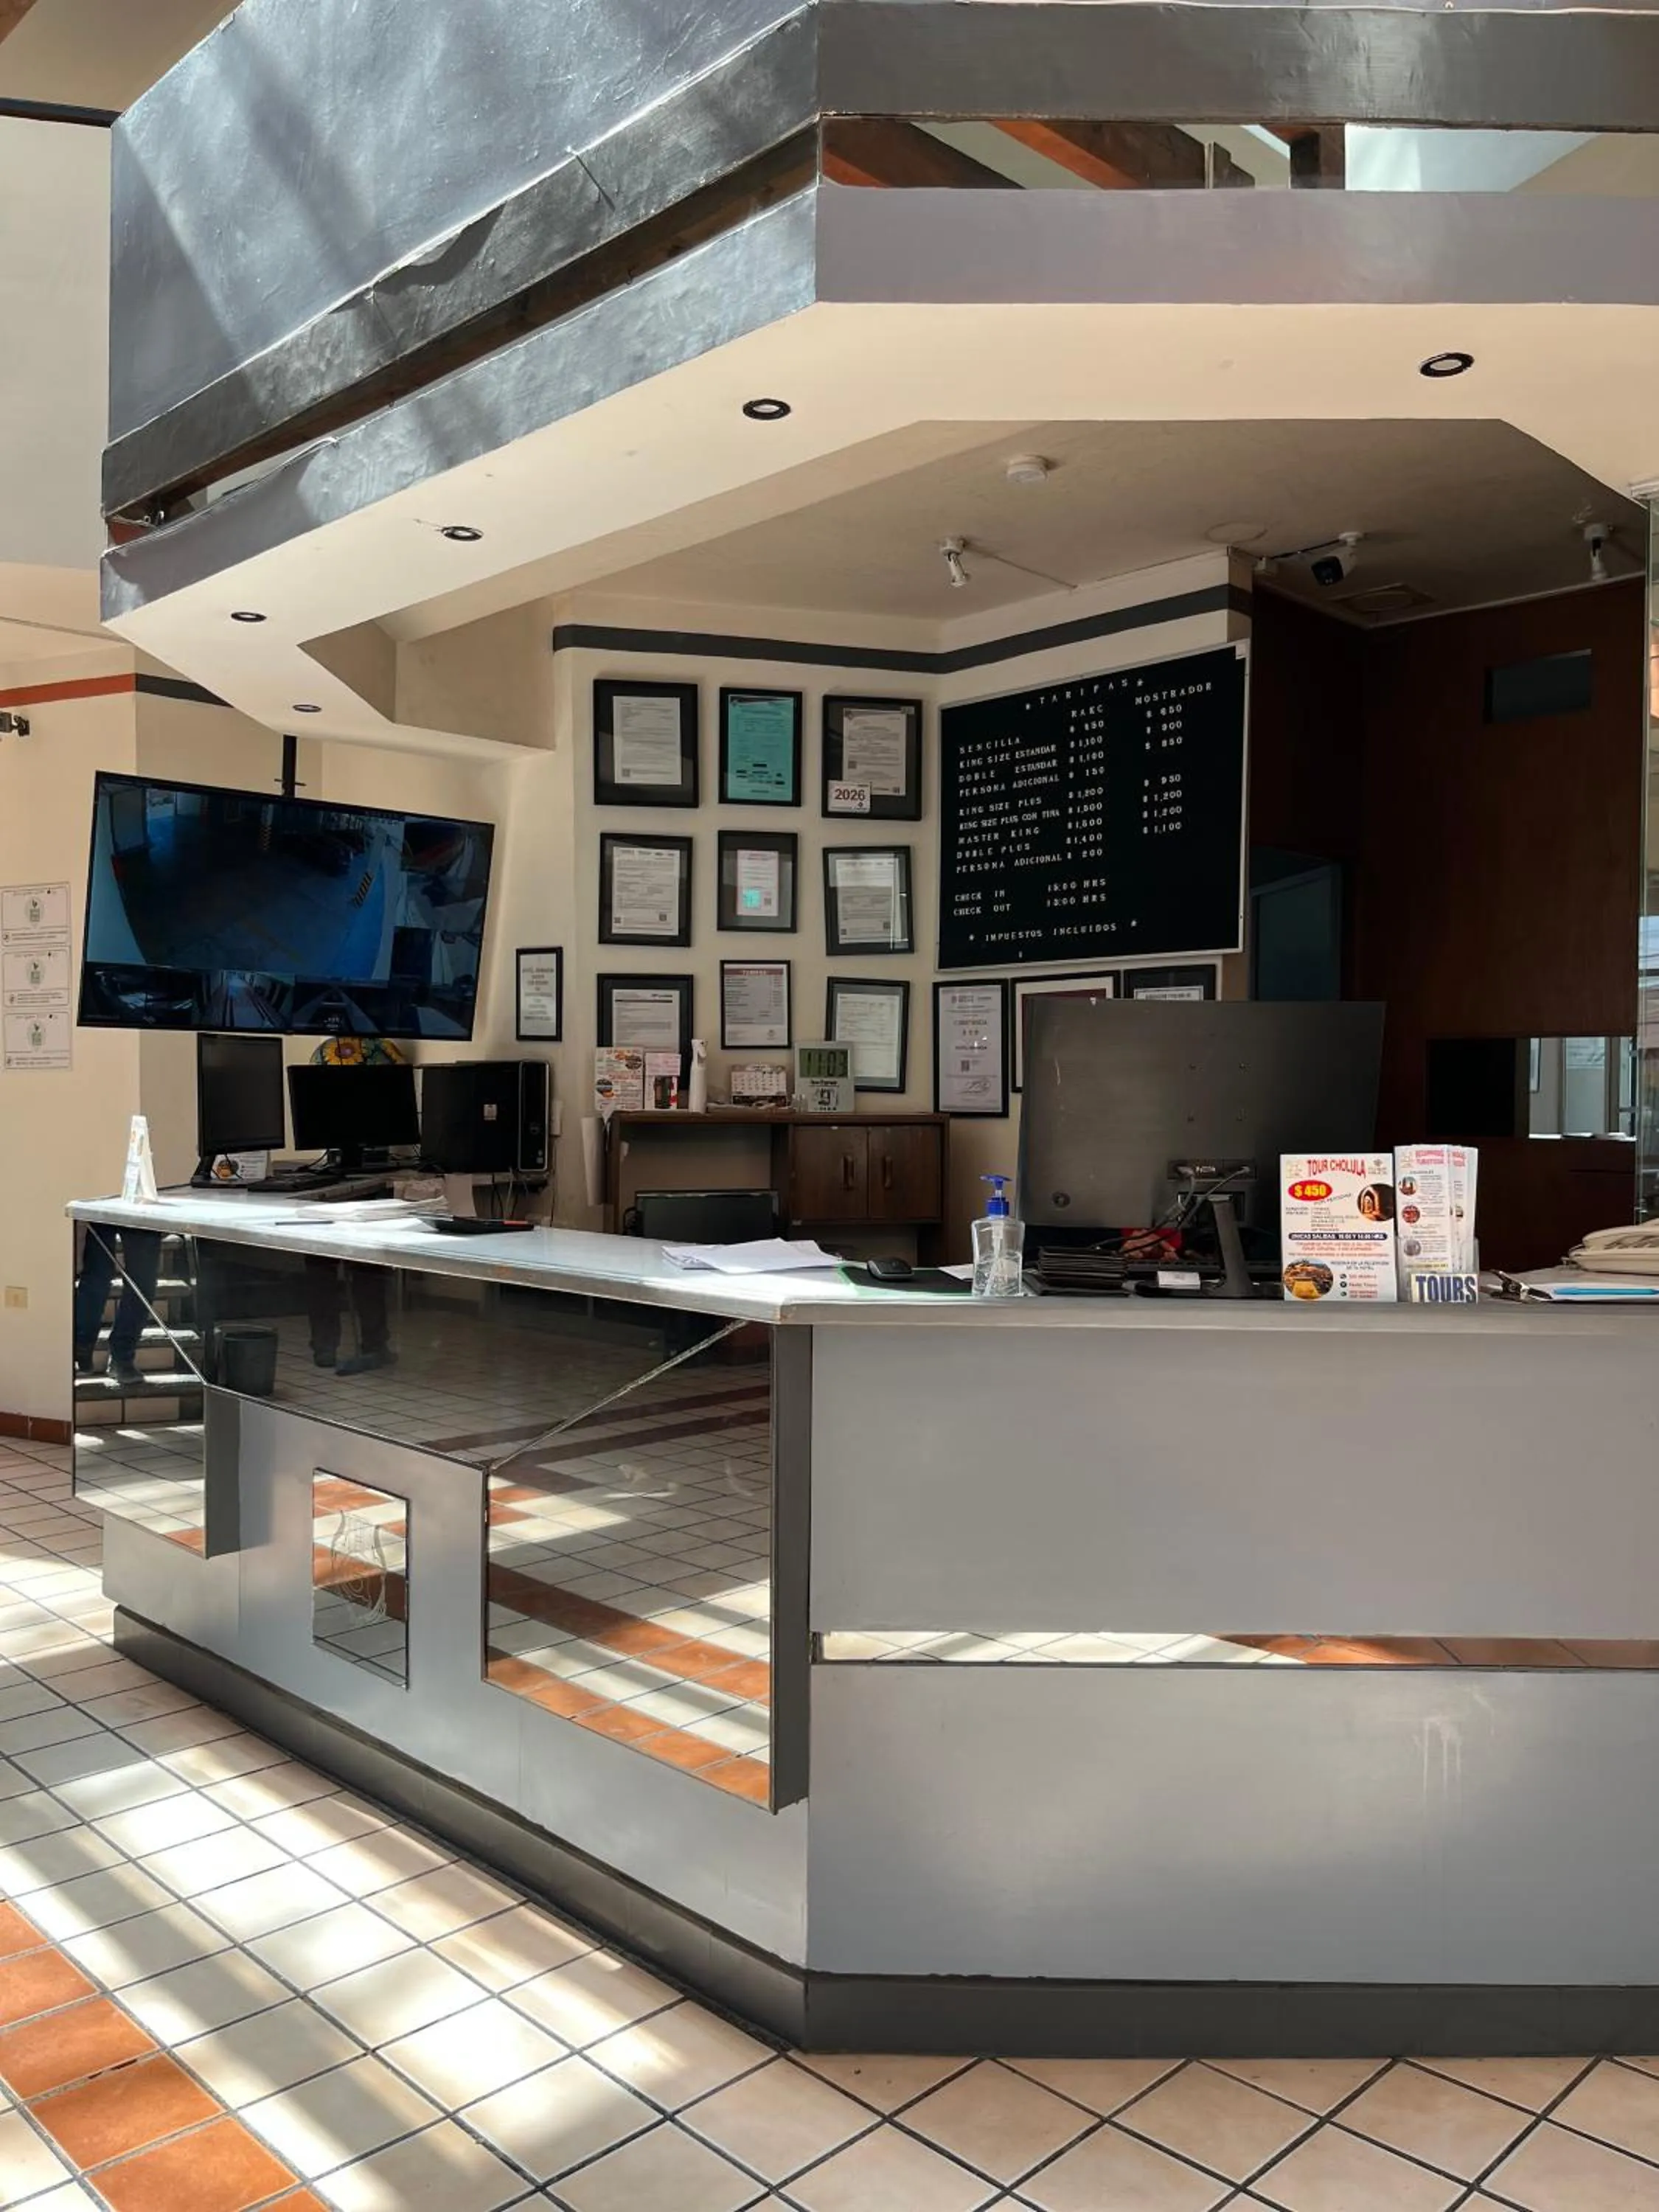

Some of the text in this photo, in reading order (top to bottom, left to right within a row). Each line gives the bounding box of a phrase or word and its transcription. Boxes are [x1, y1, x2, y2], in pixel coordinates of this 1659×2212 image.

[1135, 682, 1211, 706] MOSTRADOR
[959, 737, 1021, 755] SENCILLA
[1015, 744, 1057, 759] ESTANDAR
[959, 770, 995, 782] DOBLE
[1015, 759, 1058, 773] ESTANDAR
[834, 788, 865, 801] 2026
[959, 783, 1006, 797] PERSONA
[1012, 774, 1060, 789] ADICIONAL
[959, 832, 999, 844] MASTER
[1011, 827, 1040, 838] KING
[956, 861, 1005, 874] PERSONA
[1014, 853, 1062, 866] ADICIONAL
[955, 891, 982, 902] CHECK
[1083, 878, 1106, 888] HRS
[953, 906, 982, 916] CHECK
[993, 903, 1011, 913] OUT
[1082, 894, 1106, 904] HRS
[985, 922, 1117, 942] IMPUESTOS INCLUIDOS
[1307, 1158, 1366, 1178] TOUR CHOLULA
[1304, 1184, 1326, 1197] 450
[1416, 1275, 1477, 1303] TOURS
